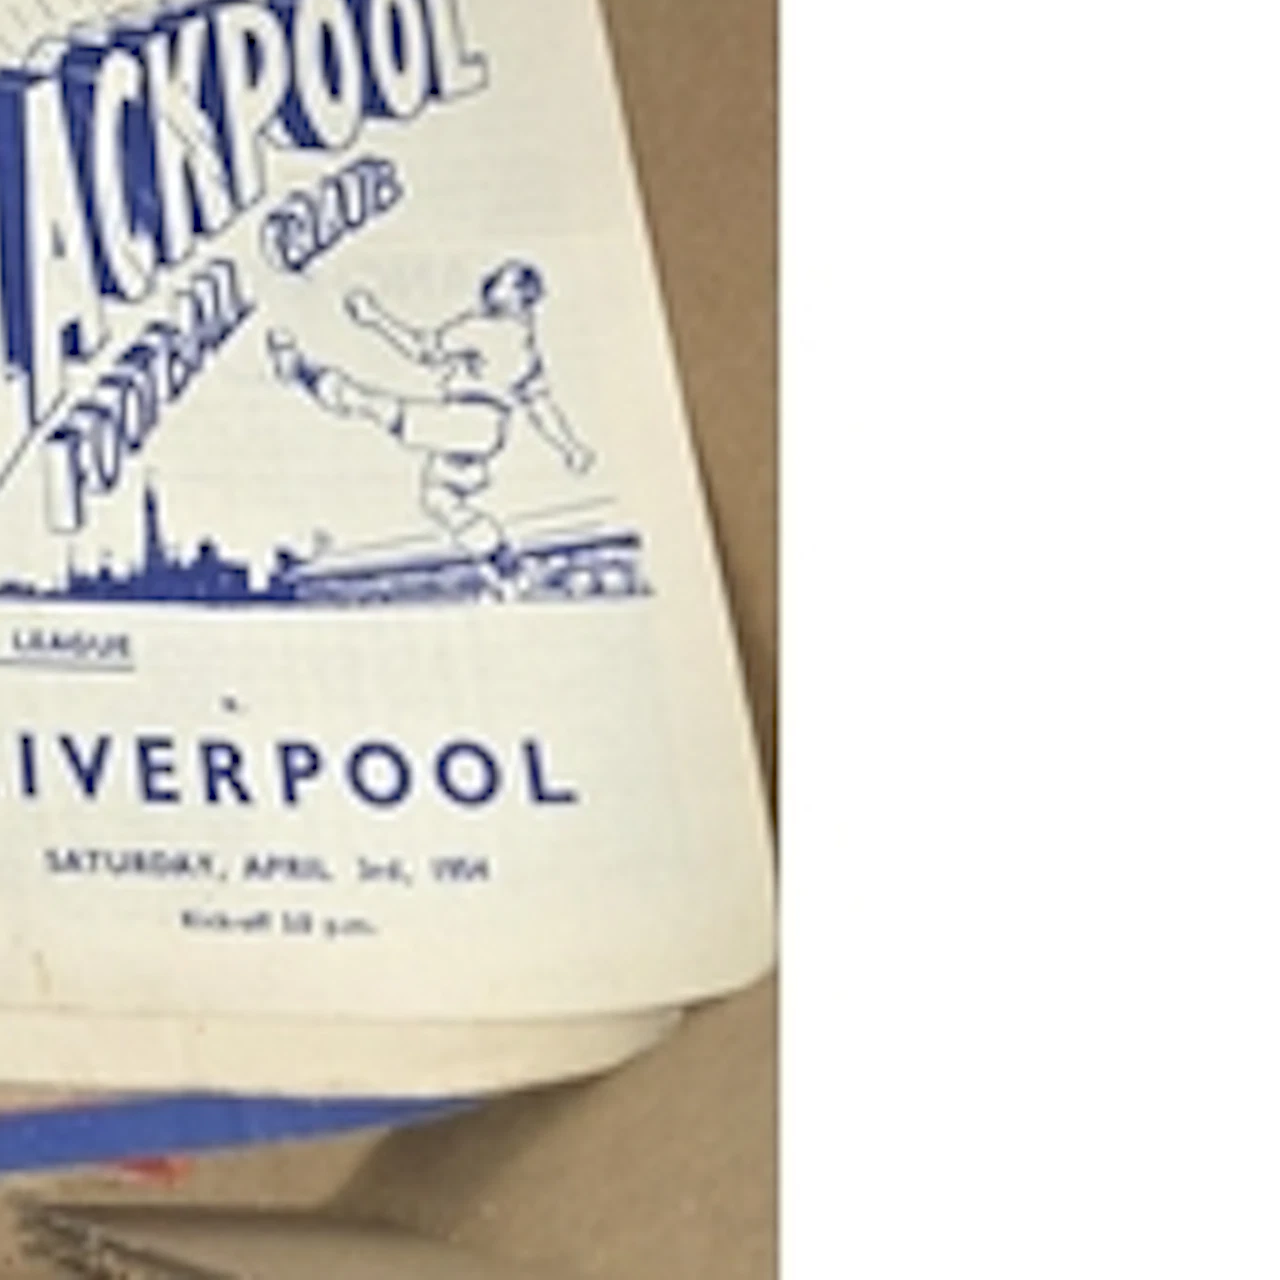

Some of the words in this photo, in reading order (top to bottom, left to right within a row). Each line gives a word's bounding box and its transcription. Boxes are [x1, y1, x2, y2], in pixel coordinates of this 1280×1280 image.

[46, 258, 256, 534] FOOTBALL
[13, 627, 132, 660] LEAGUE
[242, 852, 333, 882] APRIL
